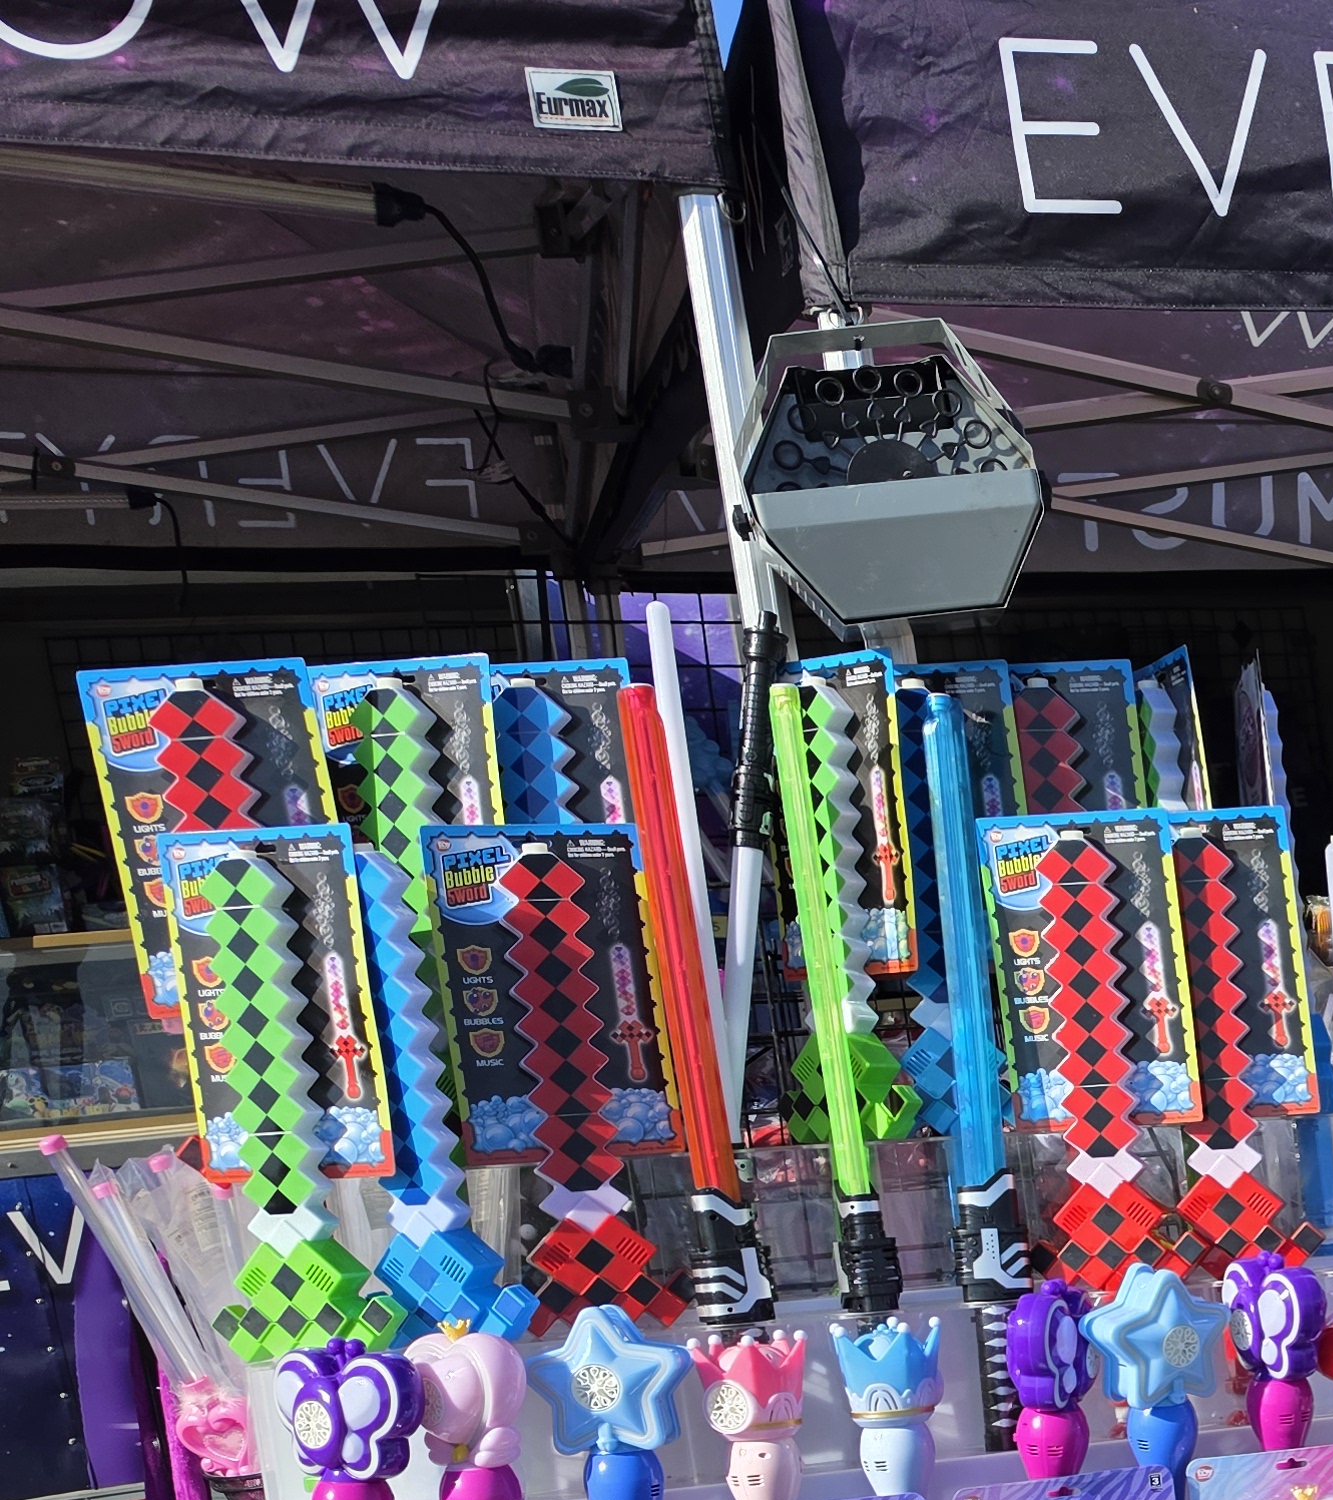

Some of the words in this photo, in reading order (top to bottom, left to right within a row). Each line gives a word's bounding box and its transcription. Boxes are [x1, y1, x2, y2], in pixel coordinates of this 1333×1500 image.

[536, 91, 609, 118] Eurmax
[107, 711, 151, 738] Bubbl
[133, 823, 166, 834] LIGHTS
[996, 835, 1054, 861] PIXEL
[443, 846, 511, 869] PIXEL
[445, 863, 495, 889] Bubble
[1000, 873, 1039, 894] Sword
[447, 885, 488, 906] Sword
[1013, 957, 1041, 967] LIGHTS
[462, 976, 494, 985] LIGHTS
[464, 1016, 504, 1026] BUBBLES
[1024, 1034, 1049, 1043] MUSIC
[476, 1058, 504, 1068] MUSIC
[1152, 1476, 1160, 1485] 3
